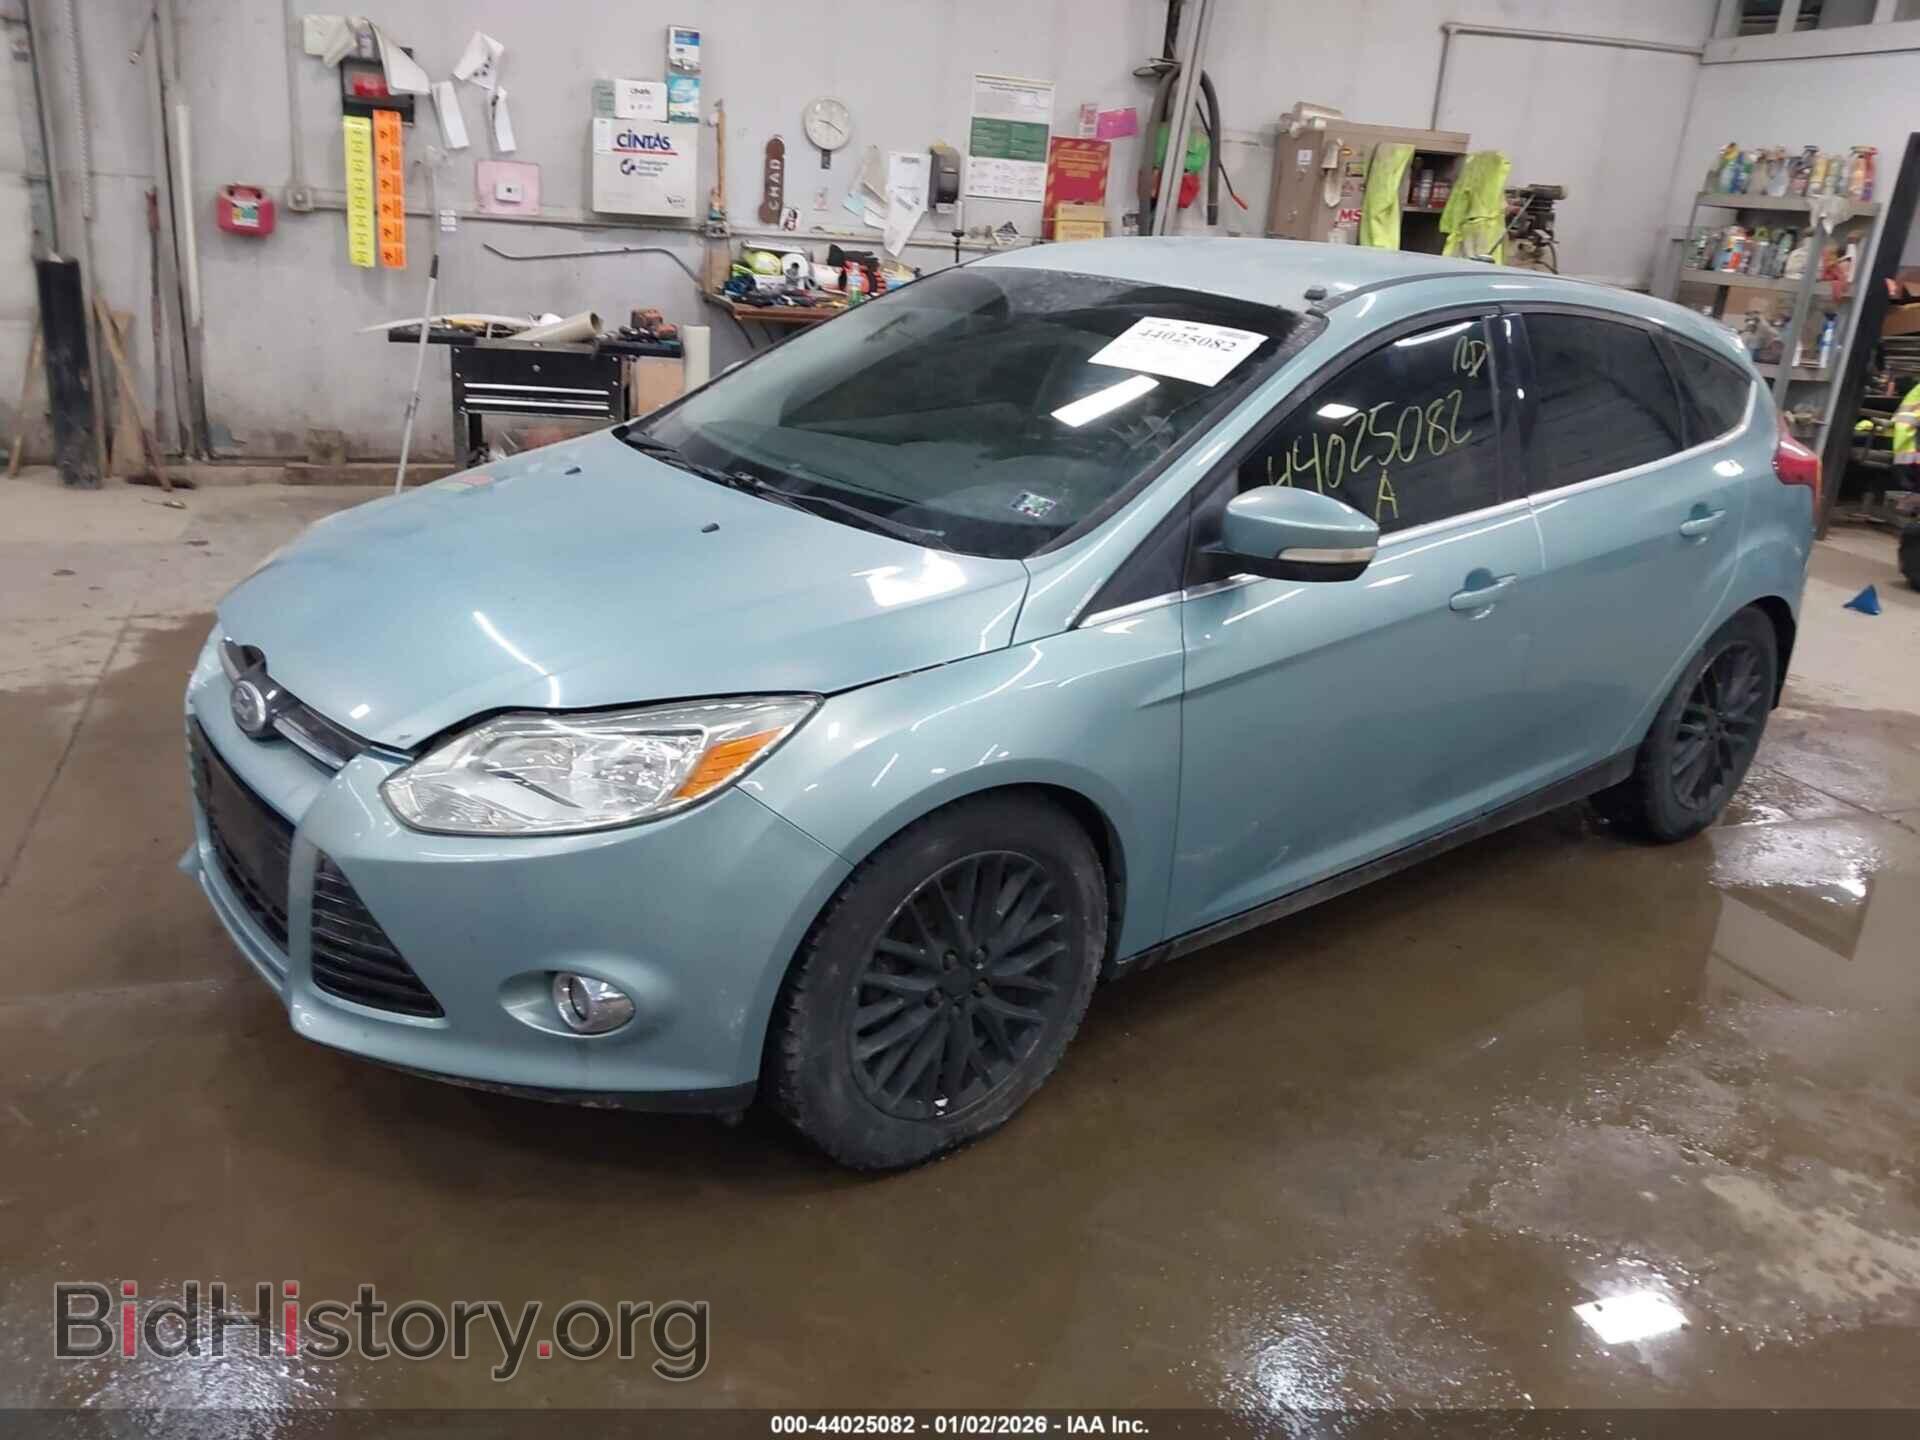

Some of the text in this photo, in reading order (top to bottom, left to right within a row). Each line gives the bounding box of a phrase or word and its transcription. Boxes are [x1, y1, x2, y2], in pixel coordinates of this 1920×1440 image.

[768, 159, 782, 210] CHAD
[1138, 328, 1237, 352] 44025082
[1267, 389, 1472, 496] 44025082
[1375, 468, 1399, 524] A
